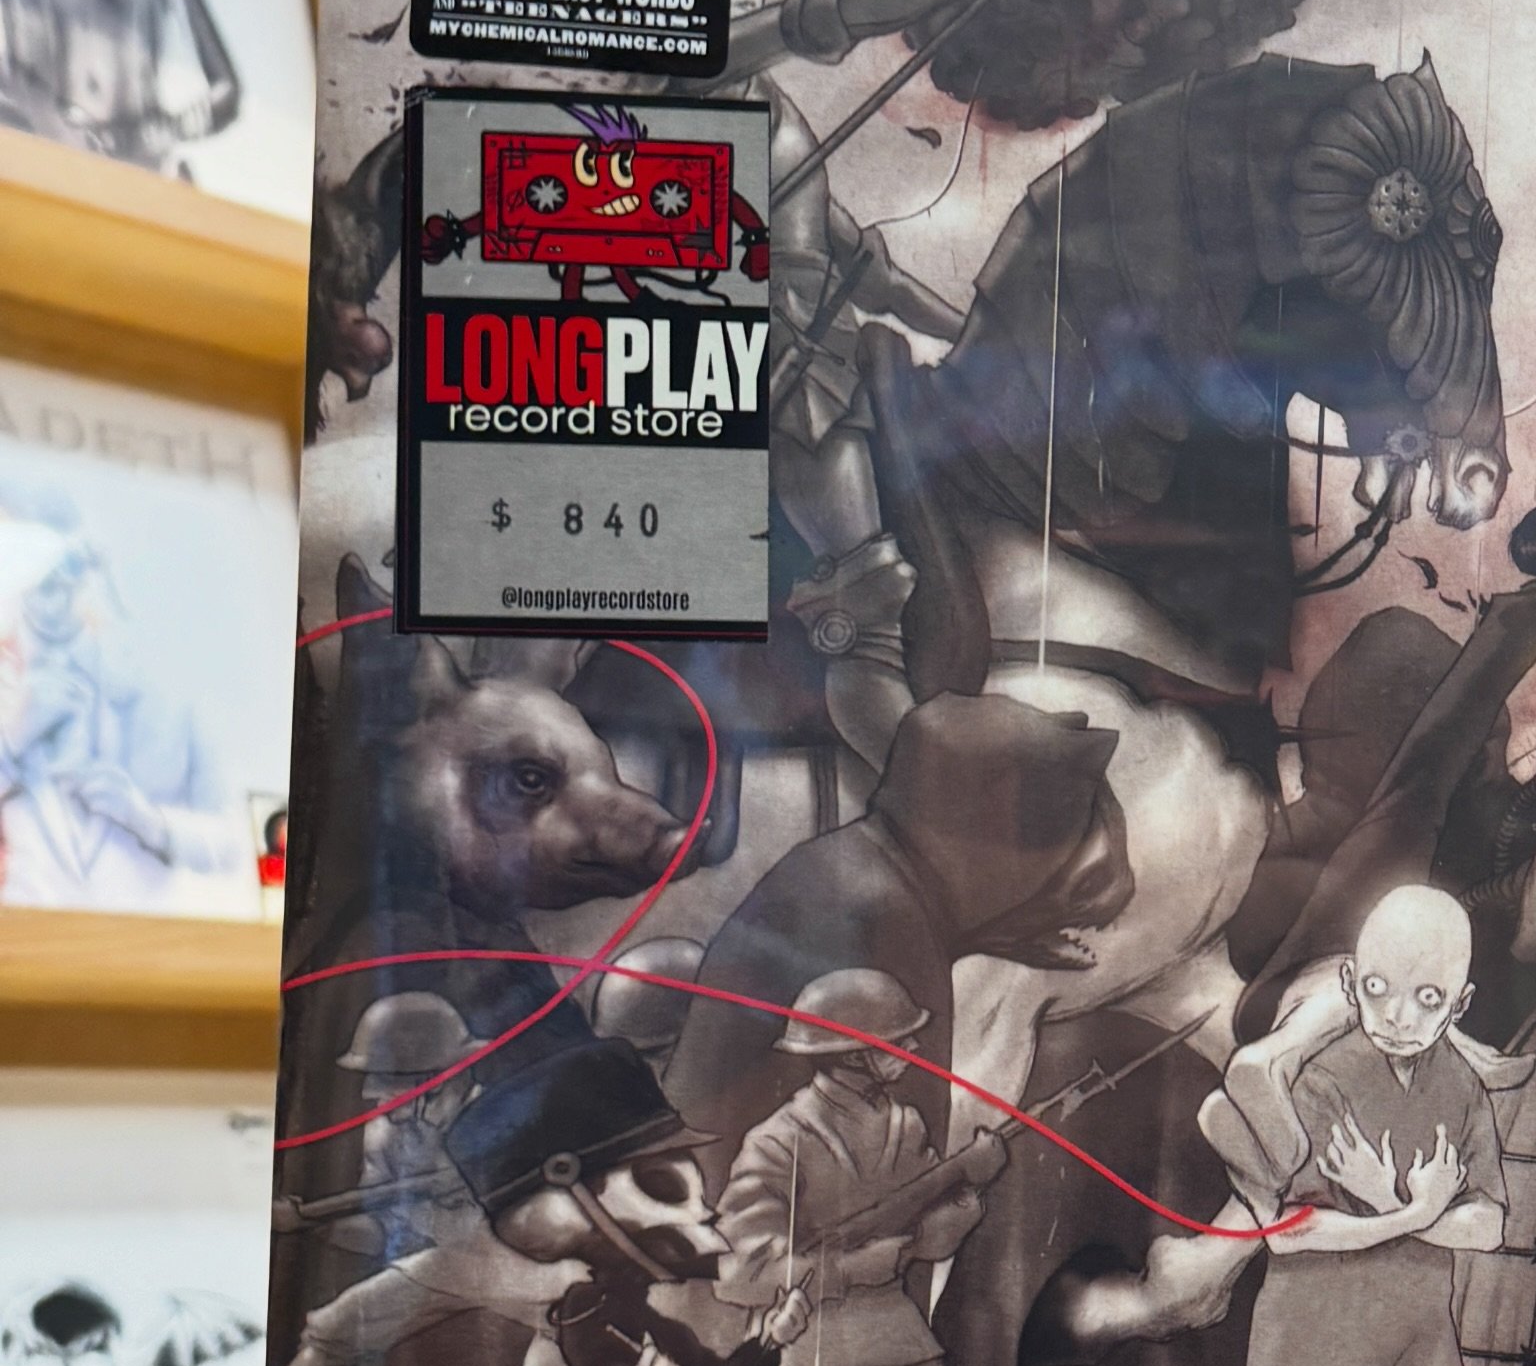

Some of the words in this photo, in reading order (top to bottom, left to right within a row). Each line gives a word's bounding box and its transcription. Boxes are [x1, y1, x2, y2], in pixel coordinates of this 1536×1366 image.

[429, 19, 708, 56] MYCHEMICALROMANCE.COM
[425, 312, 769, 412] LONGPLAY
[448, 400, 596, 435] record
[610, 406, 724, 438] store
[490, 498, 512, 533] $
[501, 586, 690, 612] @longplayrecordstore
